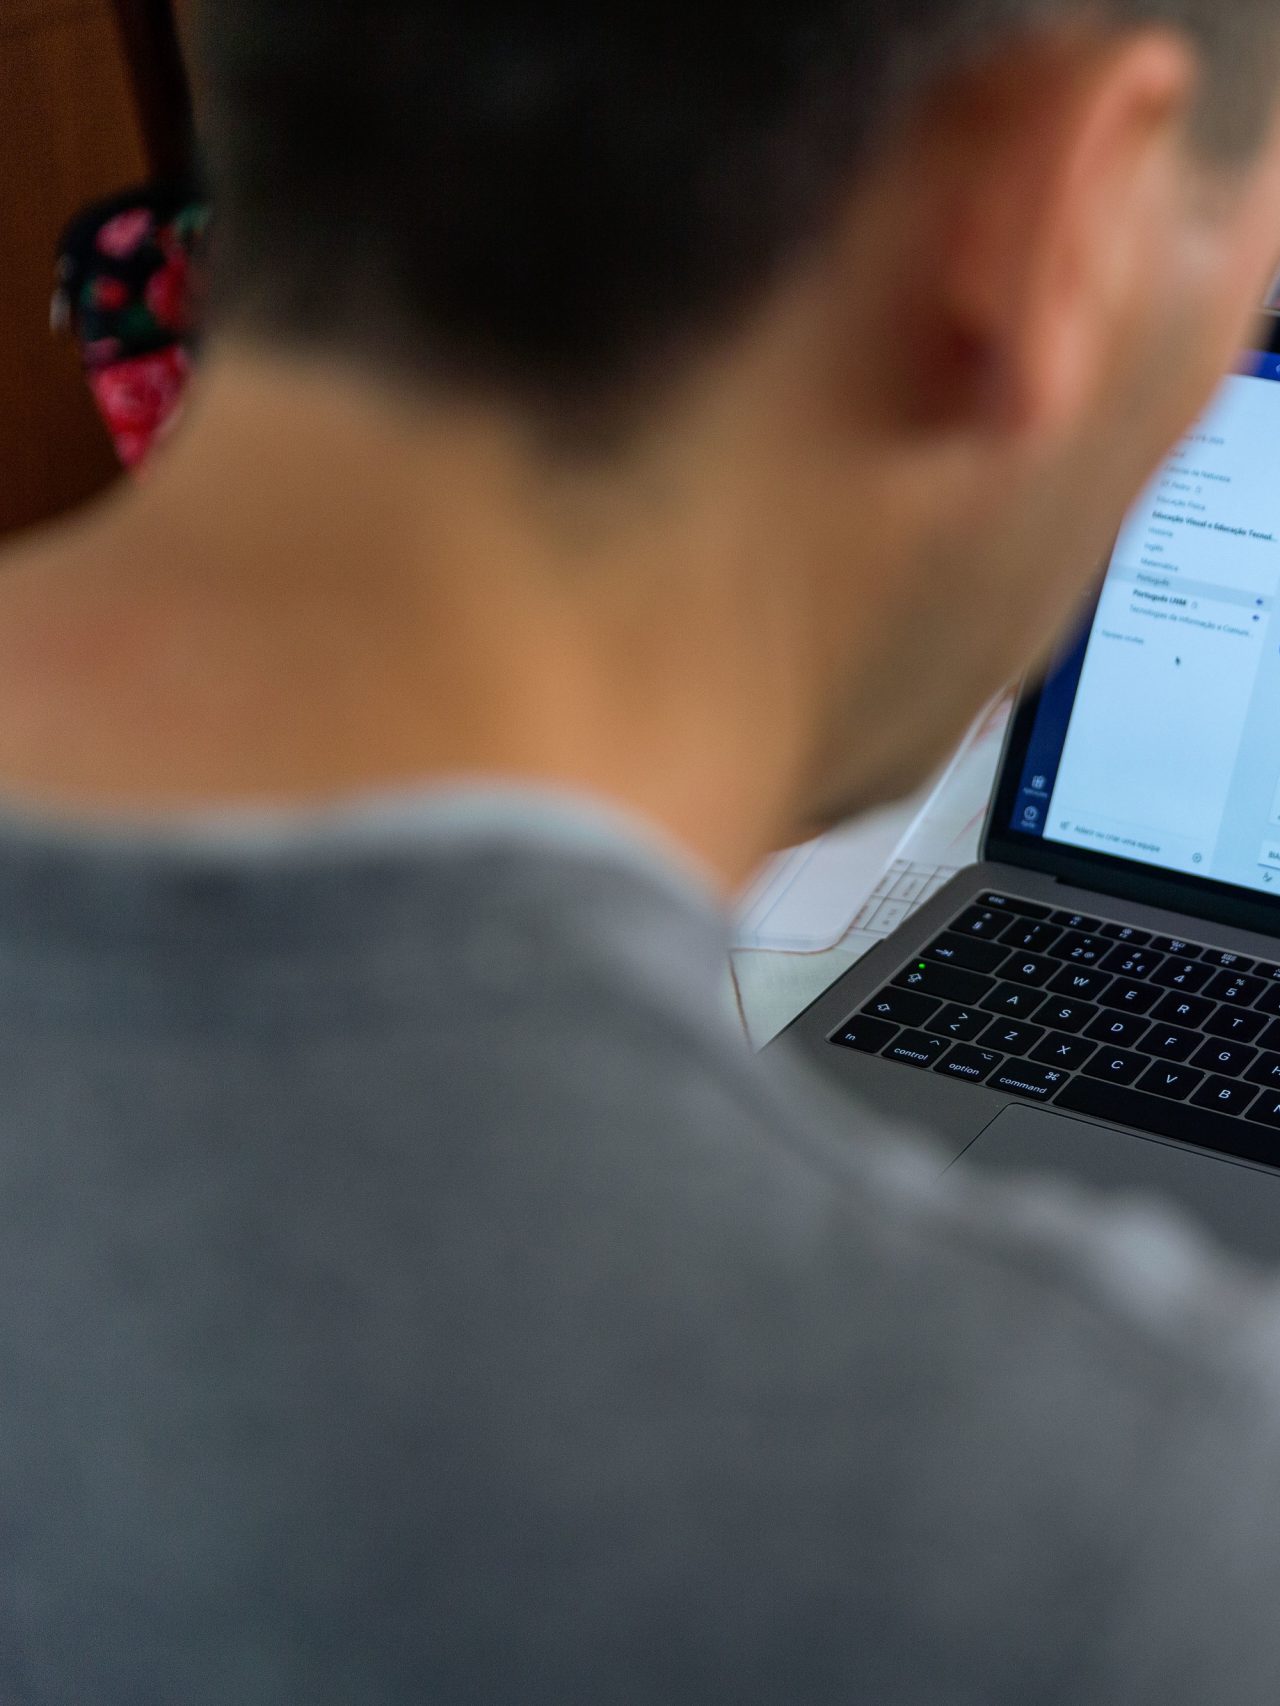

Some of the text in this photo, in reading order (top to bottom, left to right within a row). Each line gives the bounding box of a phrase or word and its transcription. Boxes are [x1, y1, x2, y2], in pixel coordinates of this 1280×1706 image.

[1071, 948, 1083, 956] 2
[1023, 964, 1035, 974] Q
[1122, 961, 1133, 969] 3
[1073, 976, 1089, 986] W
[1125, 991, 1137, 999] E
[1226, 988, 1237, 996] 5
[1006, 996, 1018, 1004] A
[1177, 1004, 1190, 1013] R
[1059, 1009, 1071, 1018] S
[1232, 1018, 1243, 1027] T
[1111, 1023, 1124, 1032] D
[1004, 1031, 1018, 1040] Z
[894, 1048, 928, 1060] control
[1057, 1045, 1071, 1055] X
[1218, 1052, 1231, 1061] G
[949, 1063, 979, 1075] option
[1111, 1060, 1124, 1069] C
[1166, 1074, 1178, 1083] V
[999, 1077, 1047, 1095] command
[1218, 1089, 1231, 1099] B
